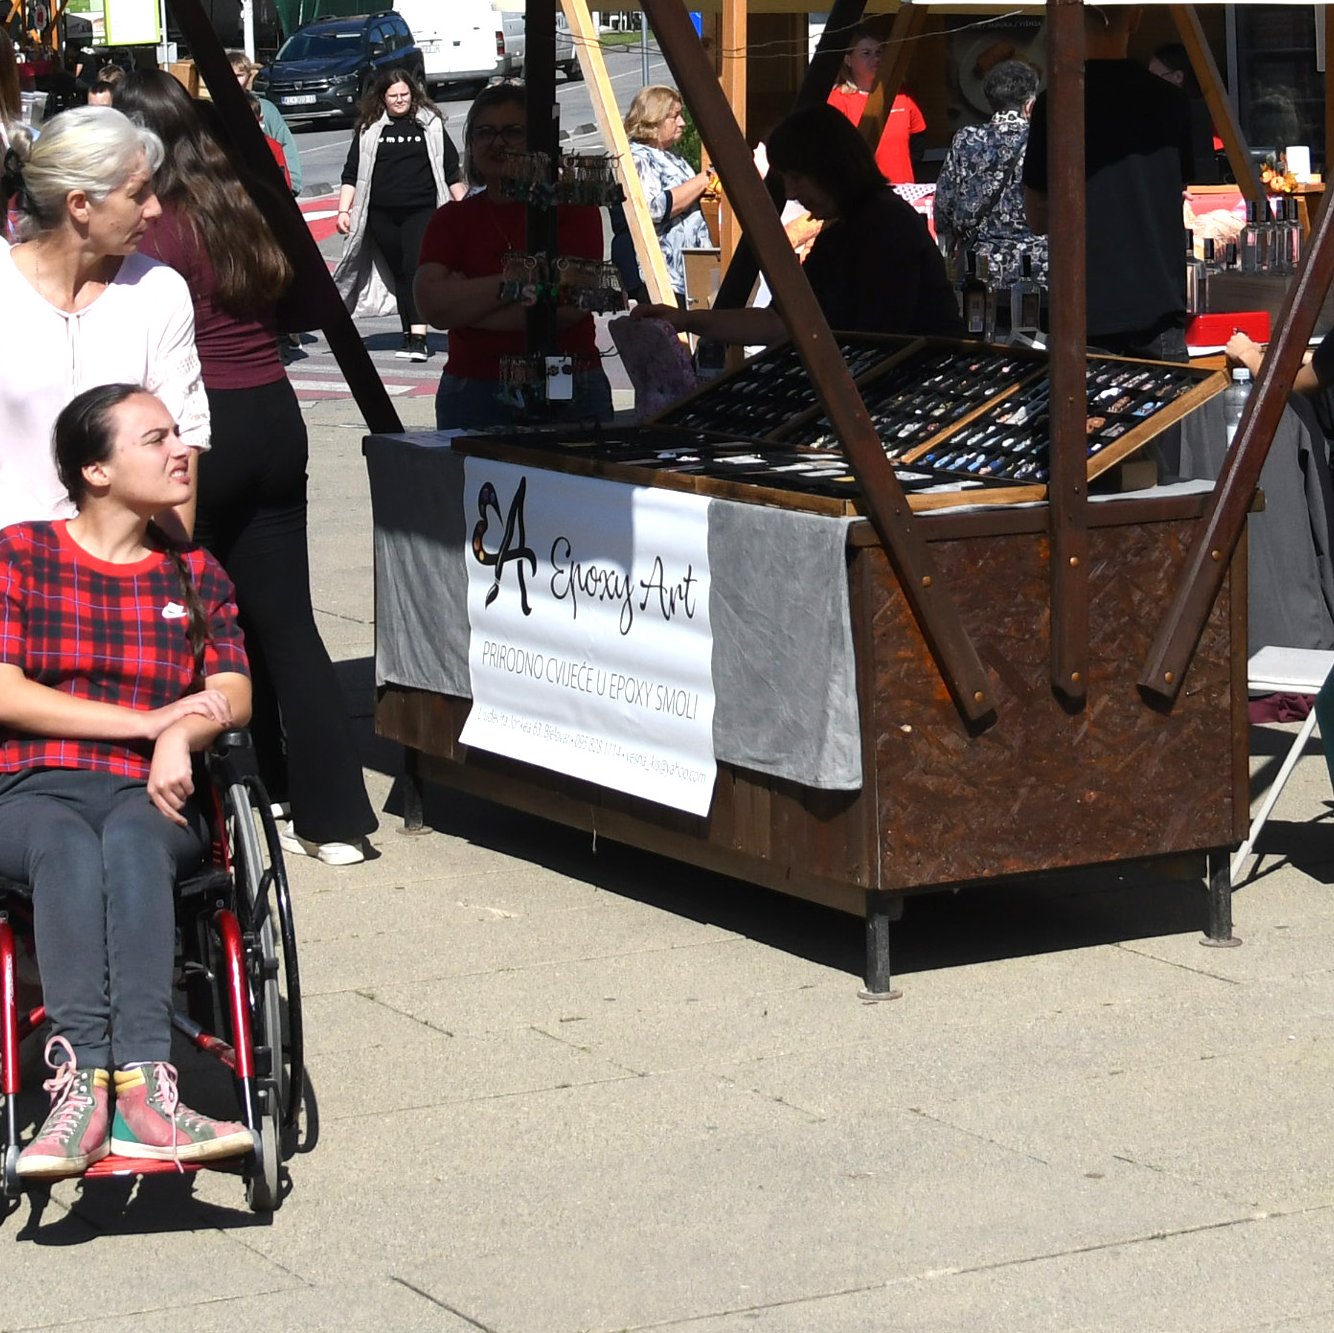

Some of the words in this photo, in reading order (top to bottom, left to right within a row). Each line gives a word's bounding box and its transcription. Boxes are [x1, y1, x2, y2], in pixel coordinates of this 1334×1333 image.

[378, 135, 422, 143] umbro
[551, 536, 635, 636] Epoxy
[640, 555, 698, 620] Art
[482, 640, 544, 680] PRIRODNO
[545, 656, 593, 693] CVIJEĆE
[596, 675, 606, 697] U
[609, 679, 655, 705] EPOXY
[655, 687, 698, 721] SMOLI
